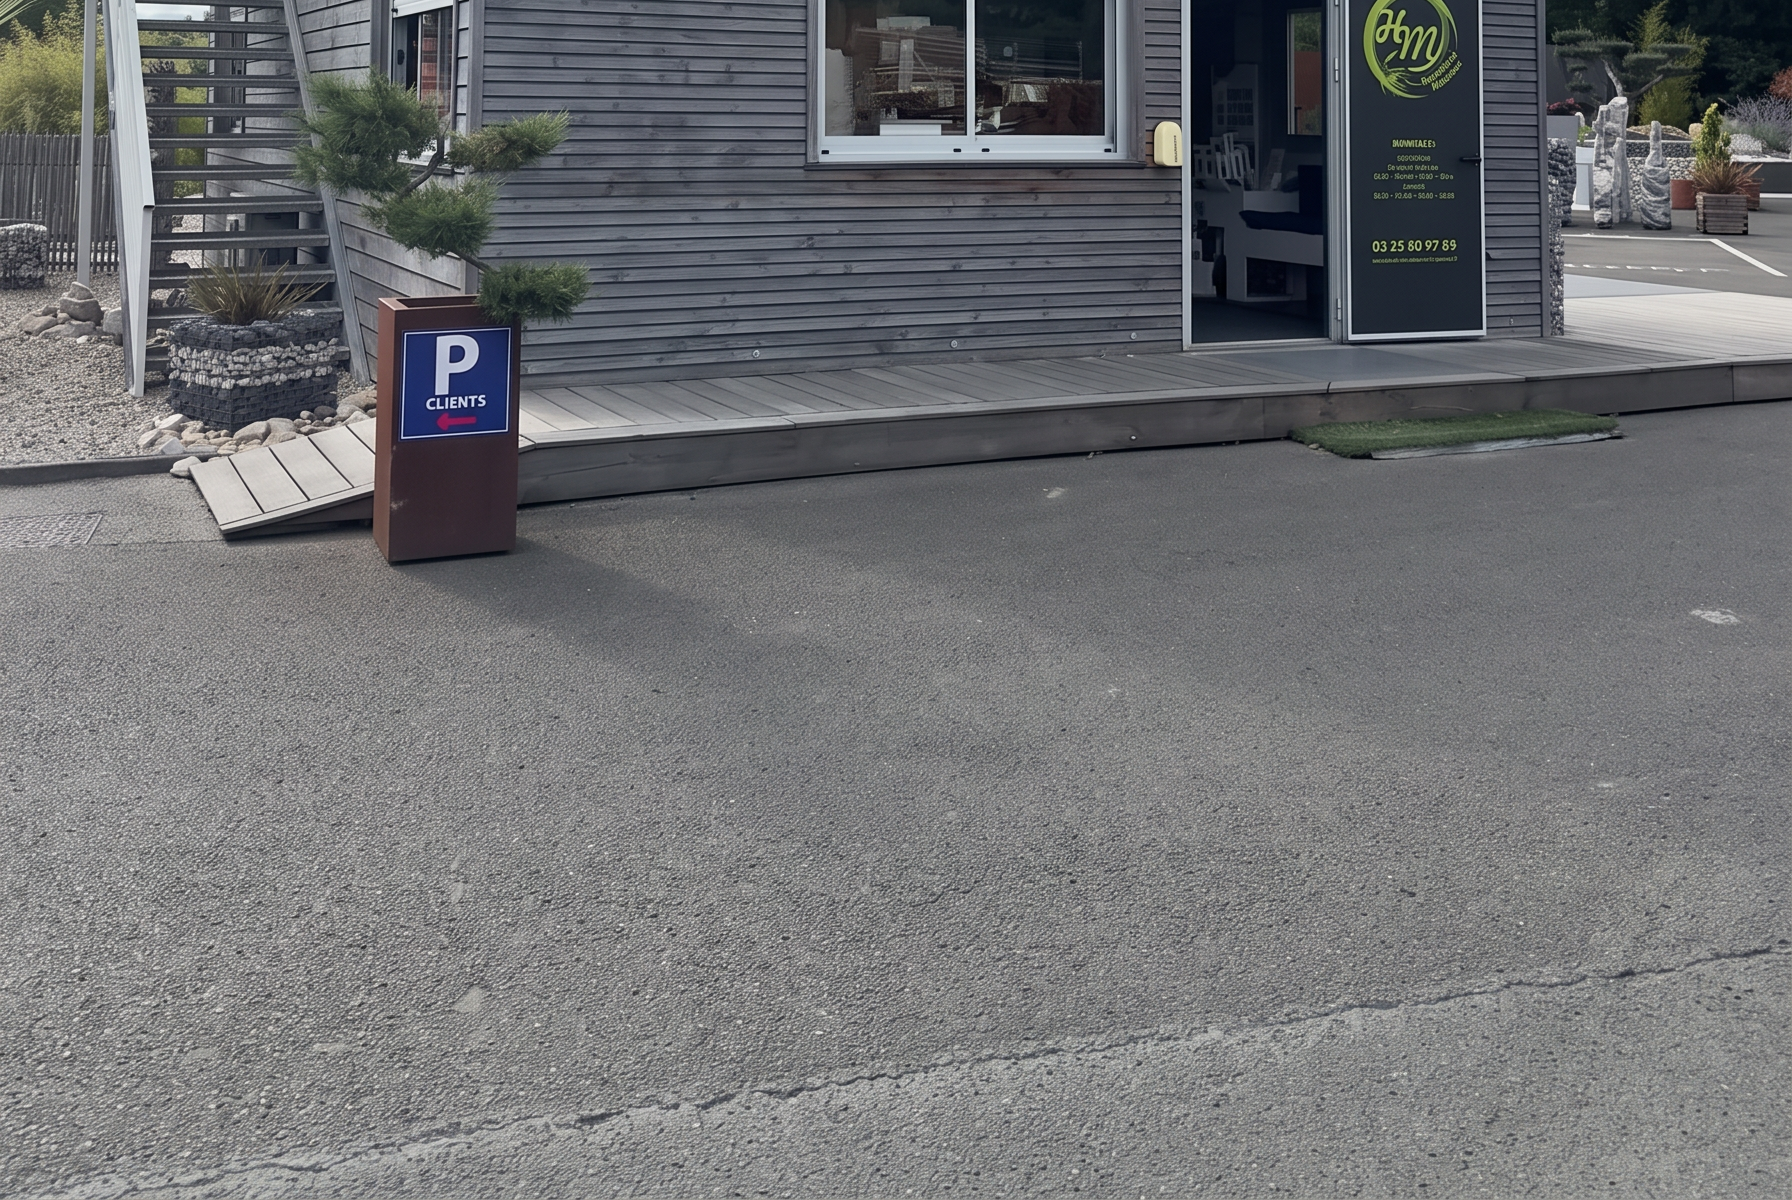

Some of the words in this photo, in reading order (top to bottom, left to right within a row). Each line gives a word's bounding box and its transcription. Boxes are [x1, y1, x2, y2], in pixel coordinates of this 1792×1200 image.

[1372, 240, 1387, 253] 03
[1390, 240, 1405, 252] 25
[1425, 239, 1440, 251] 97
[435, 334, 479, 395] P
[425, 394, 487, 410] CLIENTS
